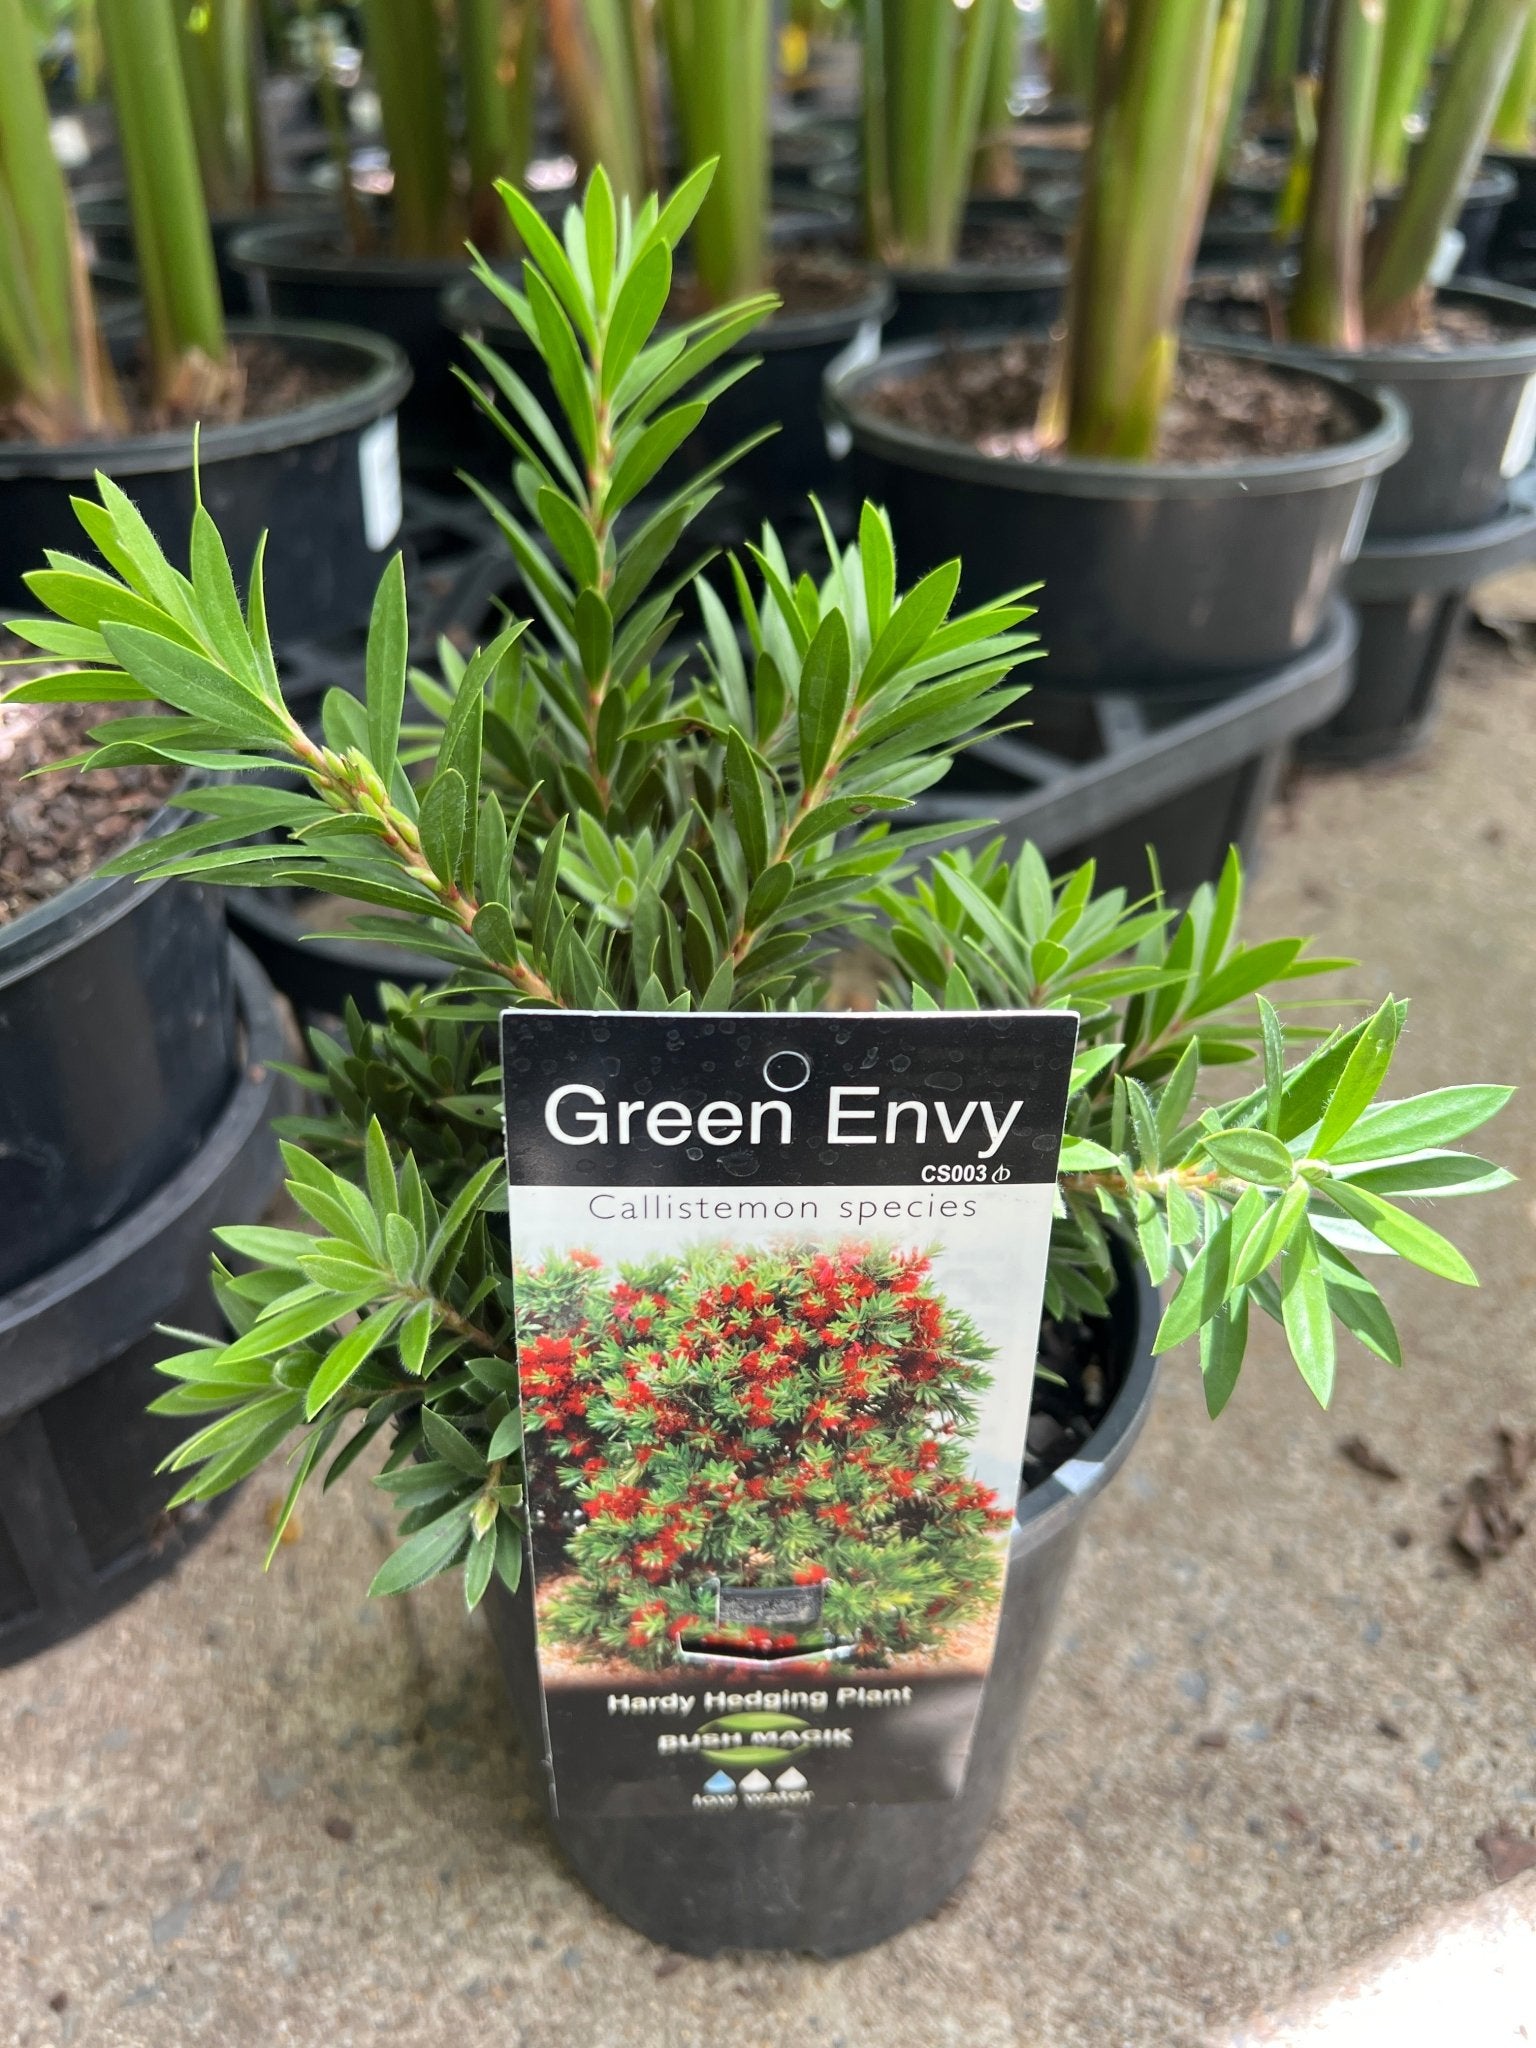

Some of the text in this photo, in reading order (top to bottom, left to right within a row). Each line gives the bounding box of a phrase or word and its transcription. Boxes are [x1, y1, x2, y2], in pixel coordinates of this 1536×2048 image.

[544, 1083, 1025, 1159] Green Envy
[920, 1163, 988, 1184] CS003
[588, 1192, 978, 1226] Callistemon species
[606, 1684, 914, 1717] Hardy Hedging Plant
[657, 1727, 854, 1755] BUSH MAGIK
